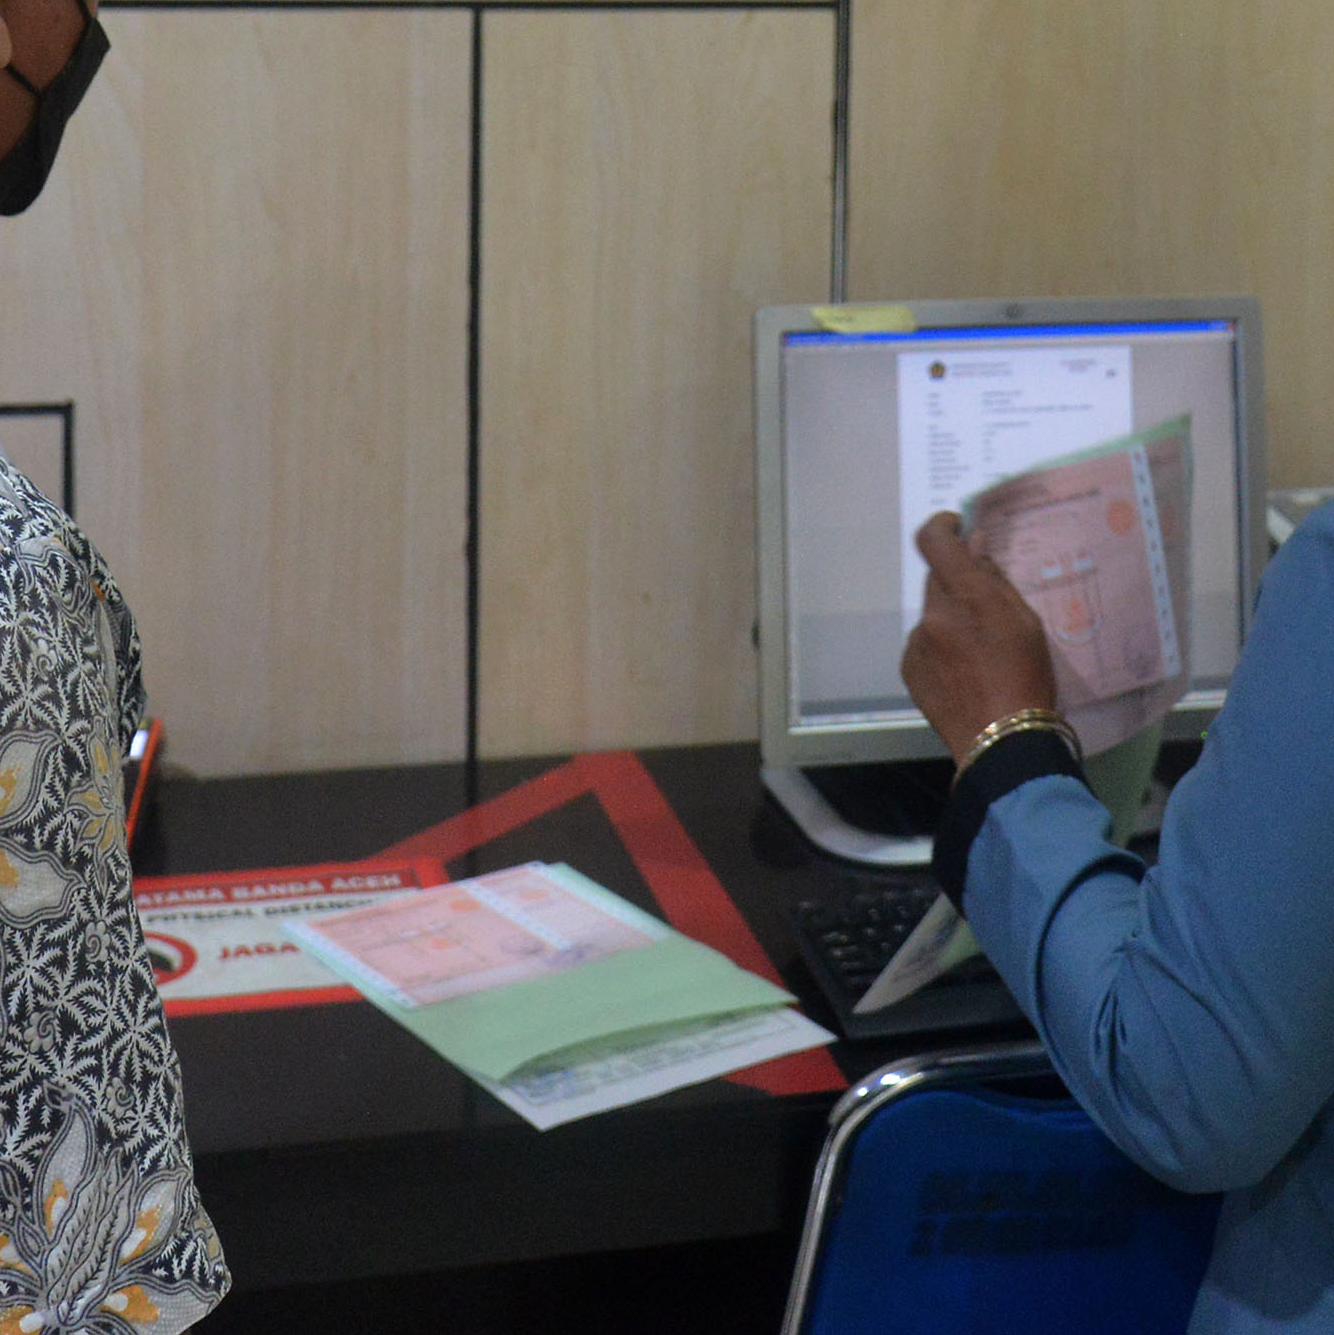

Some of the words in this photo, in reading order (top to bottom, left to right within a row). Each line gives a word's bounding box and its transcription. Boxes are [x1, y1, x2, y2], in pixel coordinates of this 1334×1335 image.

[135, 885, 226, 906] ATAMA
[230, 879, 325, 901] BANDA
[331, 872, 403, 892] ACEH
[218, 941, 301, 961] JAGA
